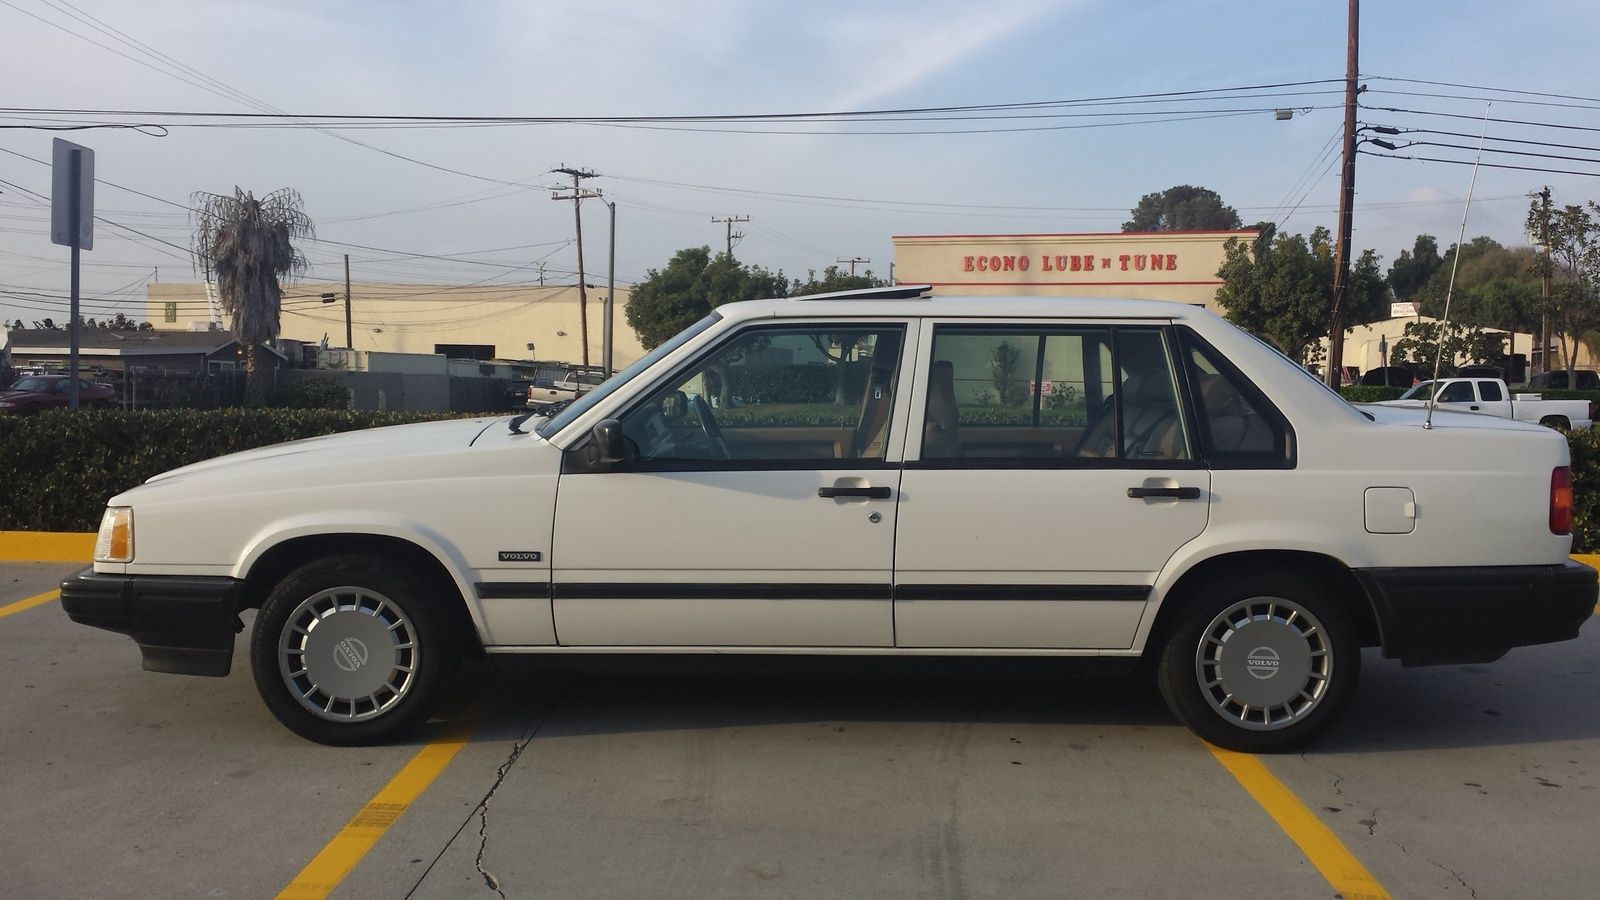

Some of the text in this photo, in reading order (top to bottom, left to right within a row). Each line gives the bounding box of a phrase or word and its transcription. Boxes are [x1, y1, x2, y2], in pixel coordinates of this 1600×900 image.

[963, 255, 1030, 271] ECONO
[1042, 254, 1095, 271] LUBE
[1119, 254, 1178, 270] TUNE
[500, 552, 538, 560] VOLVO
[340, 641, 360, 669] VOLVO
